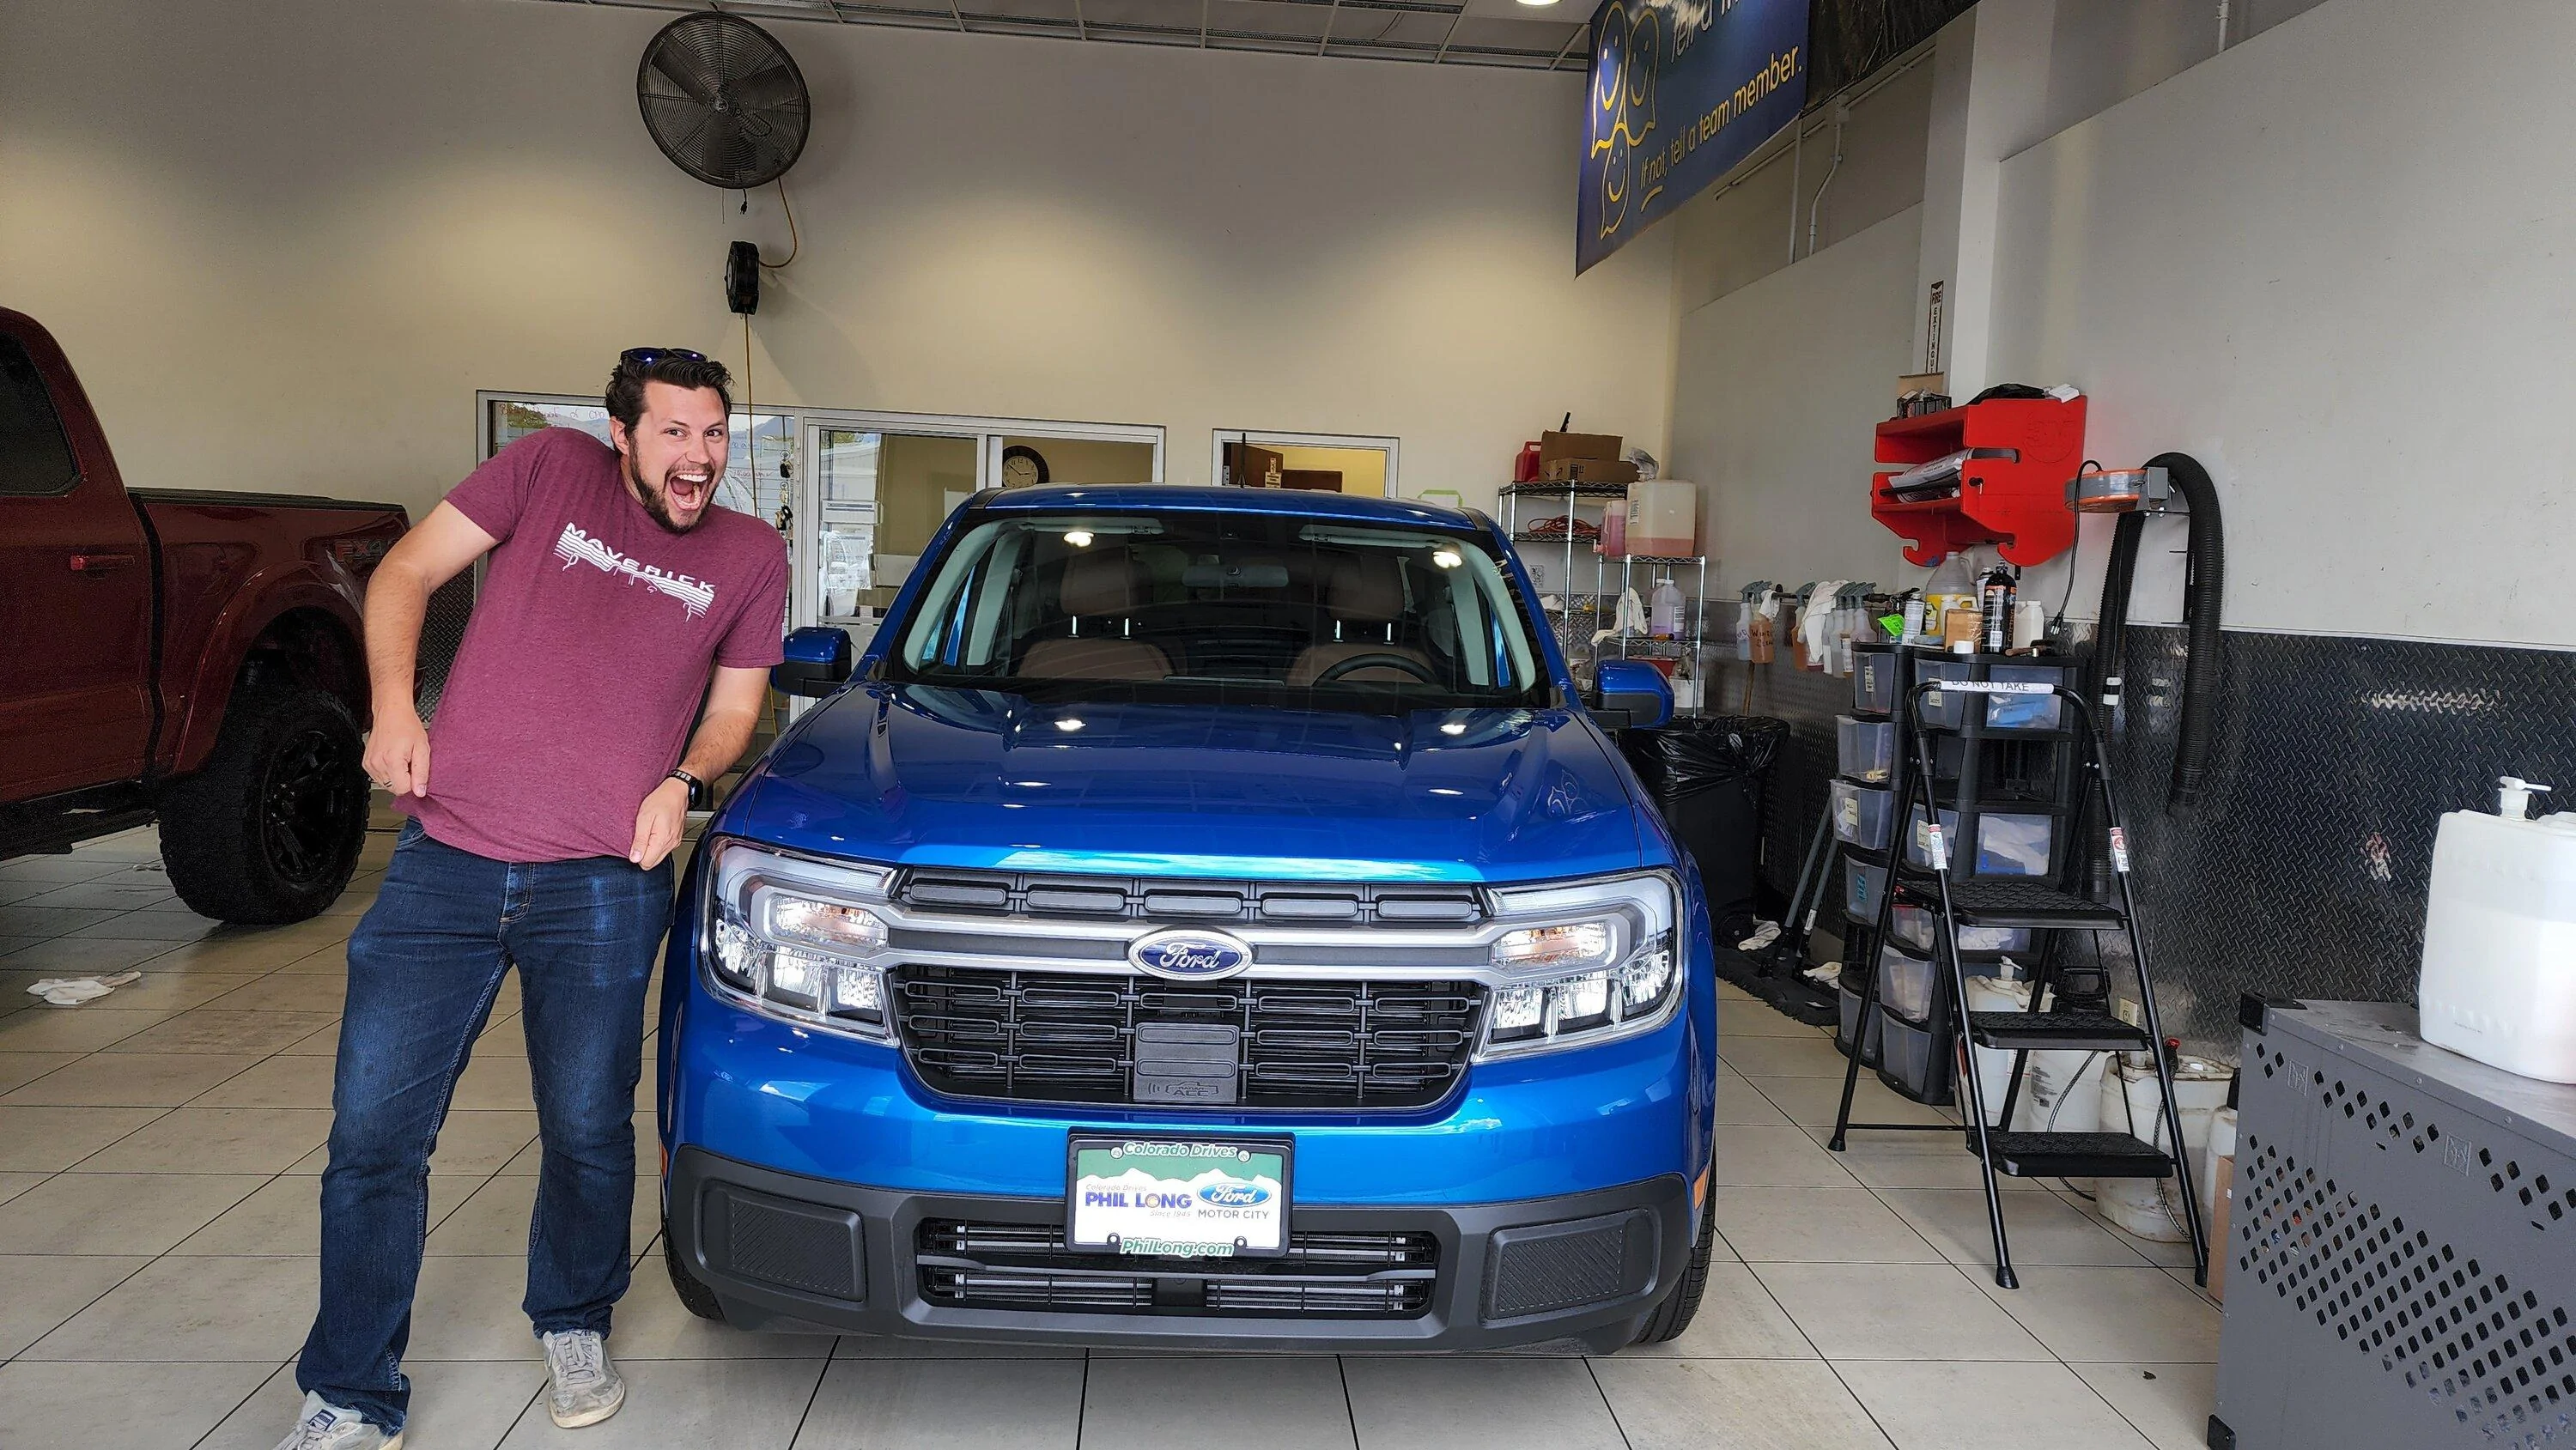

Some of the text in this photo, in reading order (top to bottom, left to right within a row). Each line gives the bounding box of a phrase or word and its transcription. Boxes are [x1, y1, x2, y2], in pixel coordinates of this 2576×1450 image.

[1640, 46, 1802, 189] If not, tell a team member.
[1929, 306, 1938, 373] EXTINGUI
[334, 539, 384, 562] FX4
[565, 522, 716, 594] MAVERICK
[1999, 683, 2029, 692] TAKE
[1159, 942, 1223, 969] Ford
[1123, 1143, 1237, 1158] Colorado Drives
[1085, 1192, 1193, 1209] PHIL LONG
[1211, 1185, 1258, 1204] Ford
[1198, 1209, 1269, 1219] MOTOR CITY
[1121, 1238, 1234, 1258] PhilLong.com
